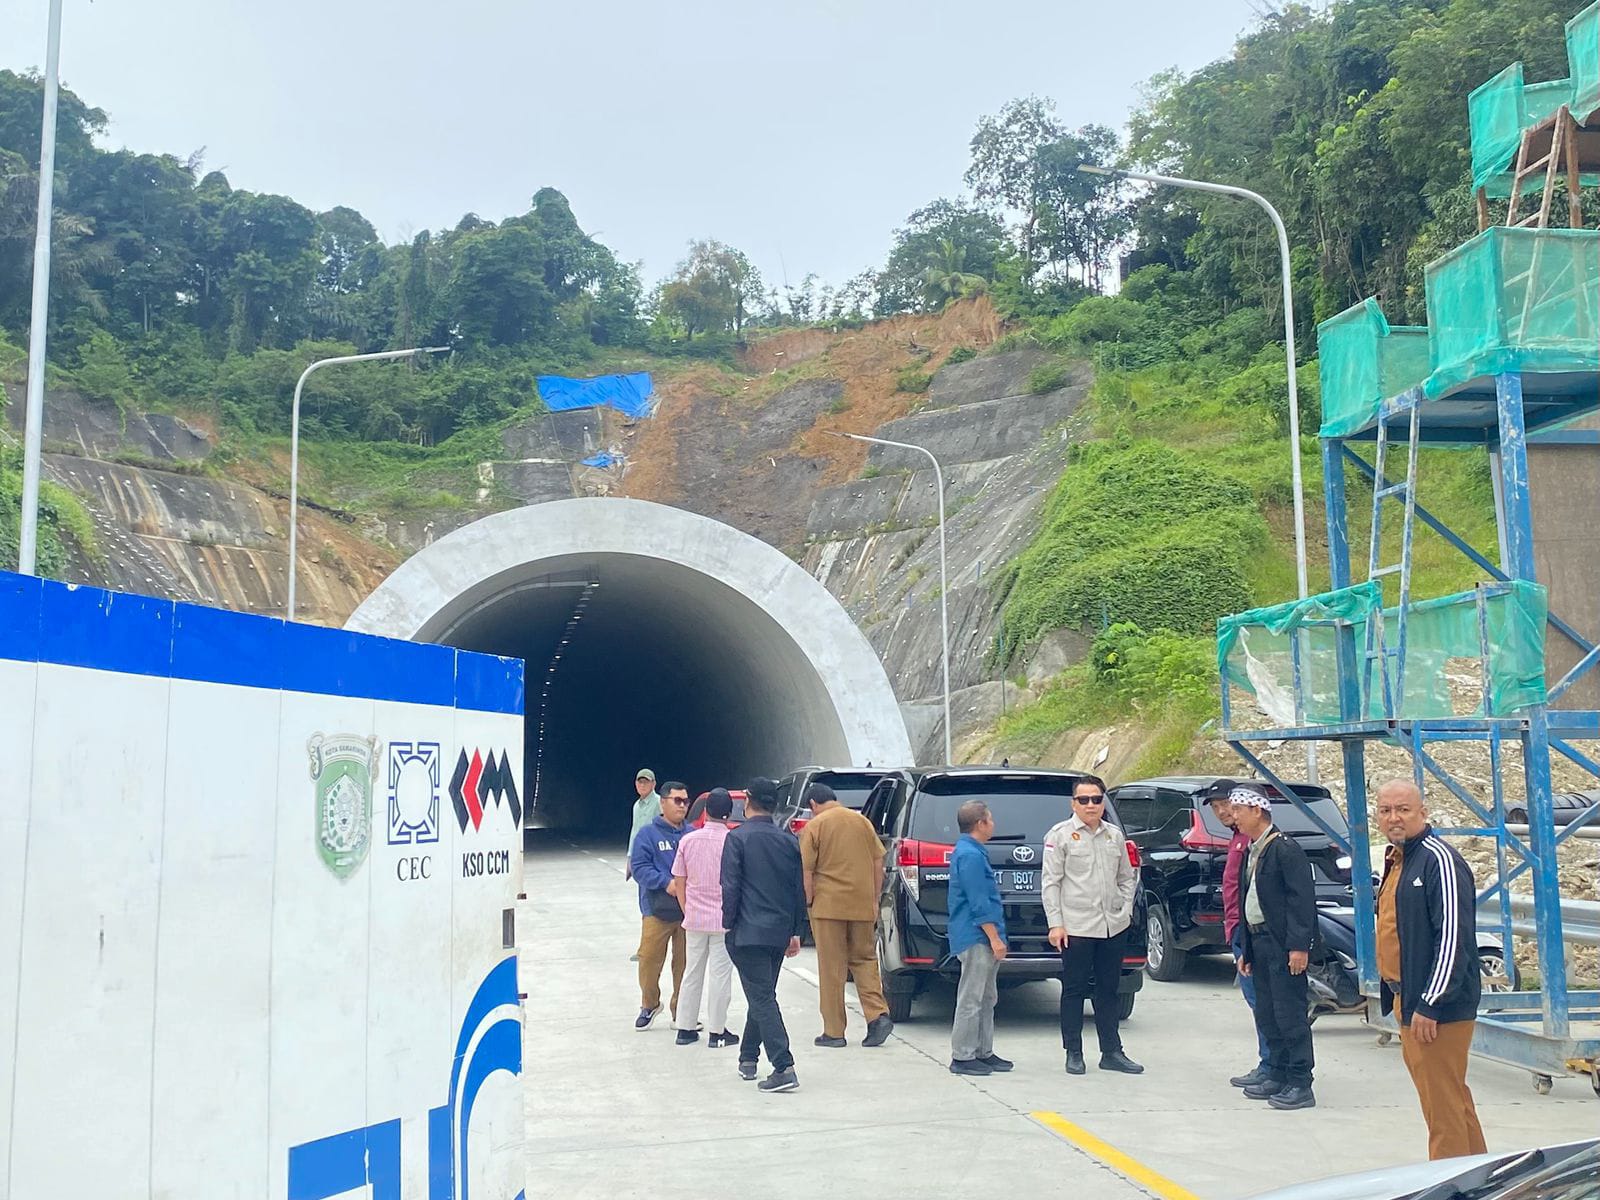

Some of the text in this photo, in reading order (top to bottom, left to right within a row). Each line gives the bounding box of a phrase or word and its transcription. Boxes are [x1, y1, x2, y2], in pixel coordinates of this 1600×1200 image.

[658, 839, 675, 851] GA
[397, 856, 432, 881] CEC
[463, 850, 509, 878] KSO CCM
[1012, 871, 1034, 884] 1607
